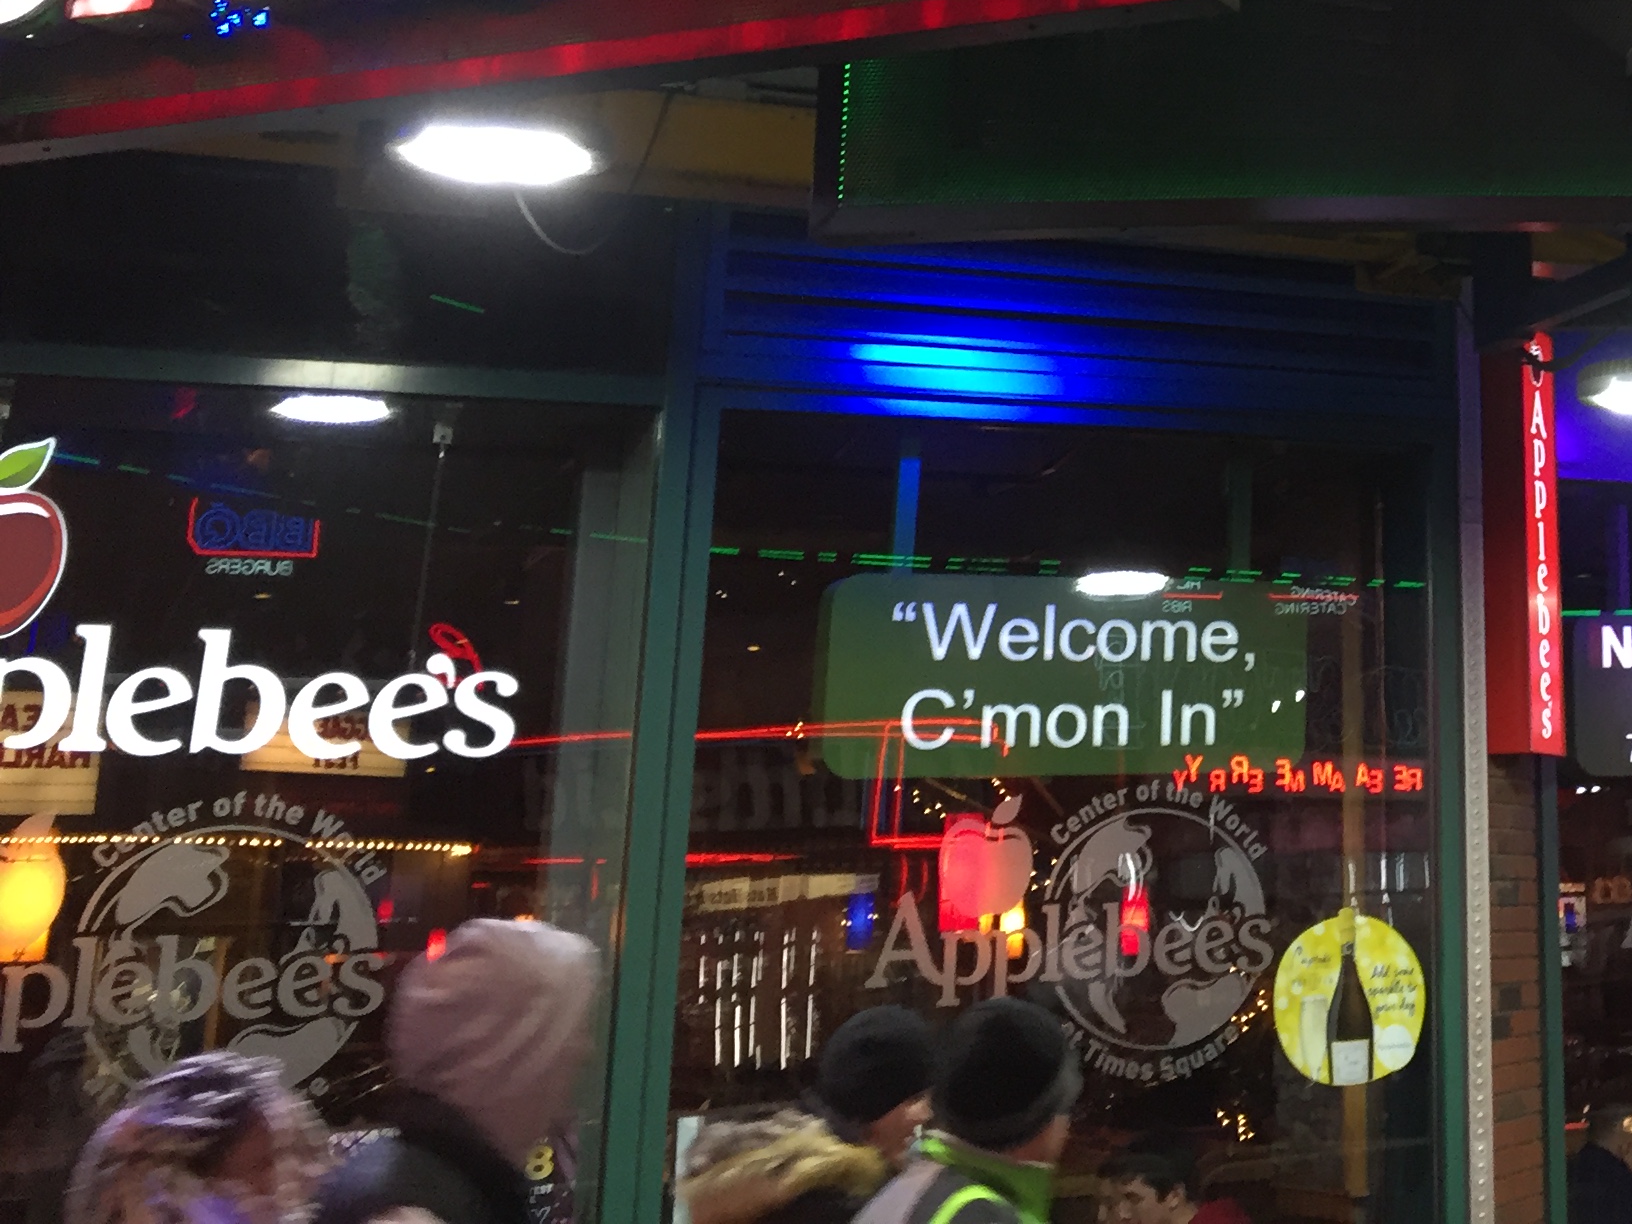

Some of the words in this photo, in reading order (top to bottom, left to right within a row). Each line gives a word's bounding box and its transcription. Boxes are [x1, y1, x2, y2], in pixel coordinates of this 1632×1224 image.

[1530, 390, 1553, 740] Applebee's
[213, 791, 247, 817] of
[254, 793, 304, 825] the
[1050, 783, 1128, 845] Center
[1135, 779, 1160, 803] of
[1165, 780, 1203, 808] the
[1209, 795, 1269, 860] World
[1084, 1039, 1153, 1080] Times
[1159, 1025, 1241, 1082] Square
